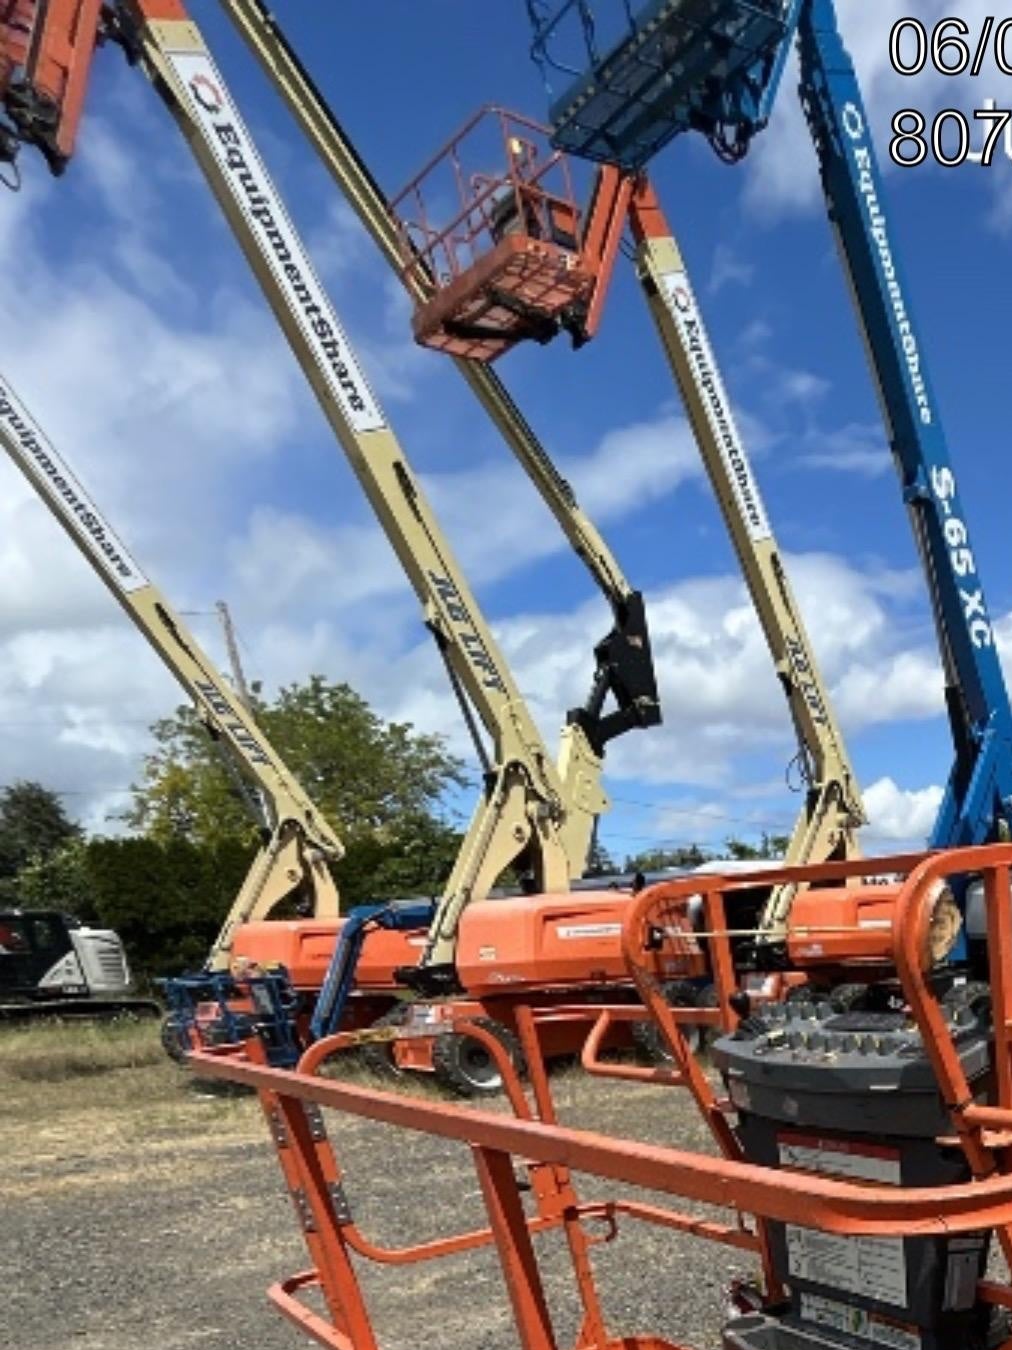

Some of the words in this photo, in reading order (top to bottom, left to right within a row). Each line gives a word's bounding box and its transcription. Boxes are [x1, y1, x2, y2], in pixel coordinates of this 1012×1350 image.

[213, 121, 365, 412] EquipmentShare
[0, 386, 132, 577] quipmentShare
[931, 465, 976, 577] S-65
[959, 588, 992, 649] XC
